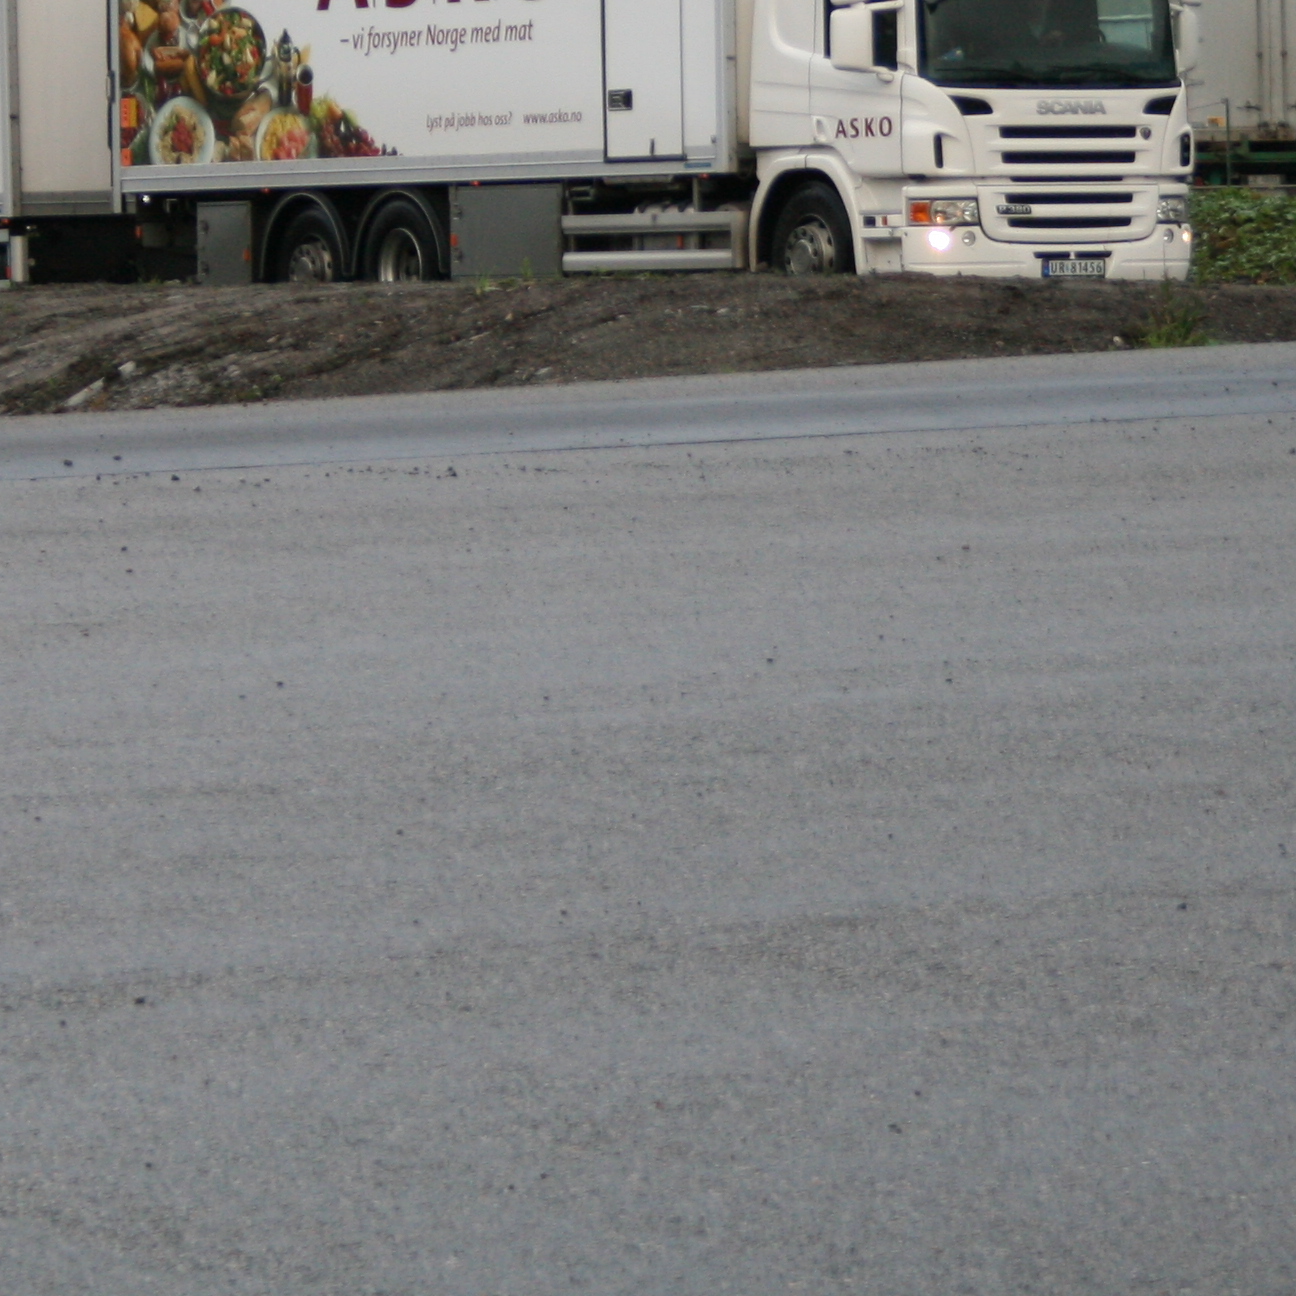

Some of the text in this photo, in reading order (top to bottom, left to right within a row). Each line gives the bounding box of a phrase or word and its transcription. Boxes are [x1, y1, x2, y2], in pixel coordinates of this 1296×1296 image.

[352, 27, 365, 50] vi
[364, 25, 422, 56] forsyner
[425, 24, 466, 52] Norge
[470, 19, 501, 43] med
[504, 19, 534, 42] mat
[1036, 100, 1107, 115] SCANIA
[444, 112, 455, 132] på
[455, 111, 477, 132] jobb
[477, 112, 493, 127] hos
[494, 111, 513, 126] oss?
[522, 109, 583, 125] www.asko.no
[835, 116, 892, 139] ASKO
[1070, 261, 1102, 274] 81456
